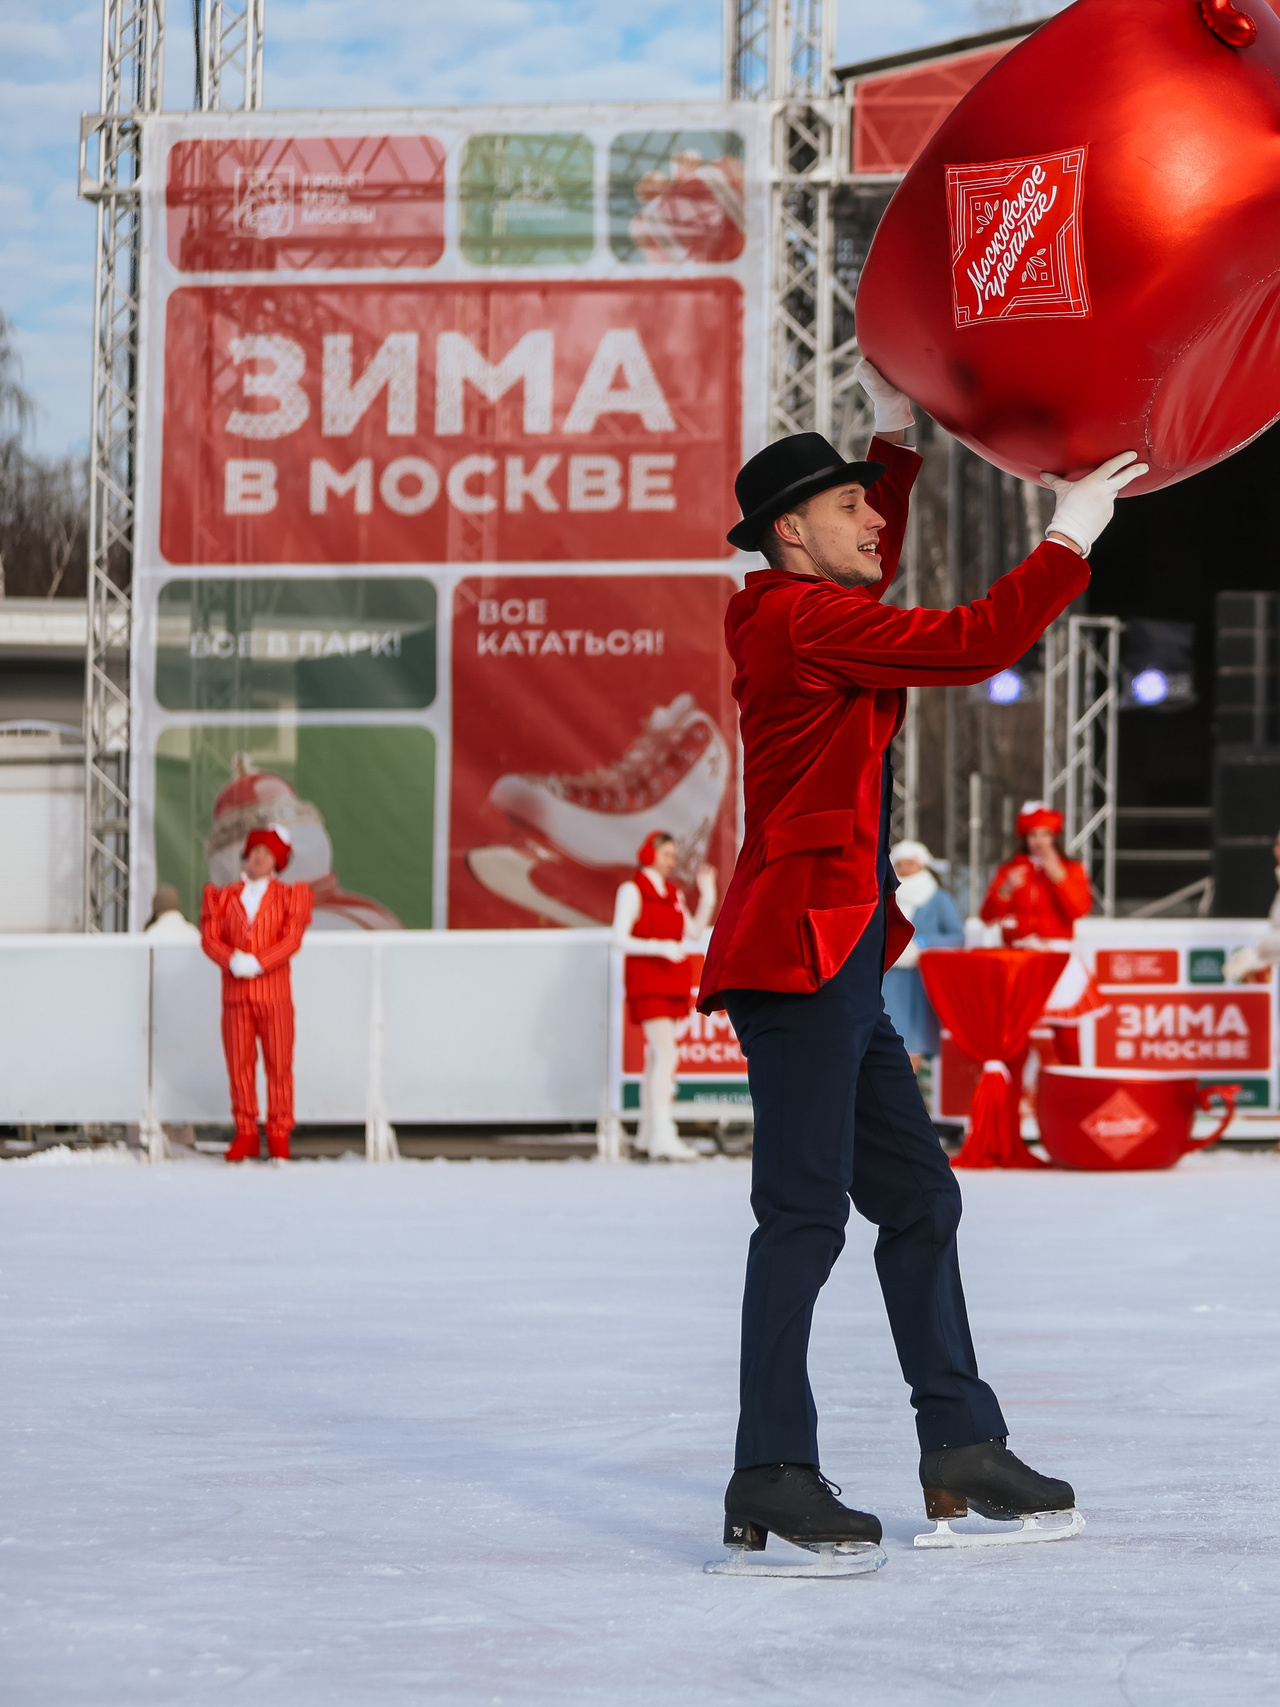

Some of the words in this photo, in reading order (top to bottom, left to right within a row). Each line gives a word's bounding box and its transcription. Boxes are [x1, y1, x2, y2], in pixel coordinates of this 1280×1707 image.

[967, 164, 1046, 315] Московское
[225, 328, 676, 440] ЗИМА
[224, 458, 278, 515] В
[309, 453, 677, 515] МОСКВЕ
[477, 598, 548, 625] ВСЕ
[190, 630, 252, 659] ВСЕ
[266, 630, 289, 659] В
[300, 630, 401, 659] ПАРК!
[477, 628, 665, 657] КАТАТЬСЯ!
[1115, 1003, 1249, 1037] ЗИМА
[1115, 1040, 1135, 1060] В
[1141, 1039, 1250, 1060] МОСКВЕ
